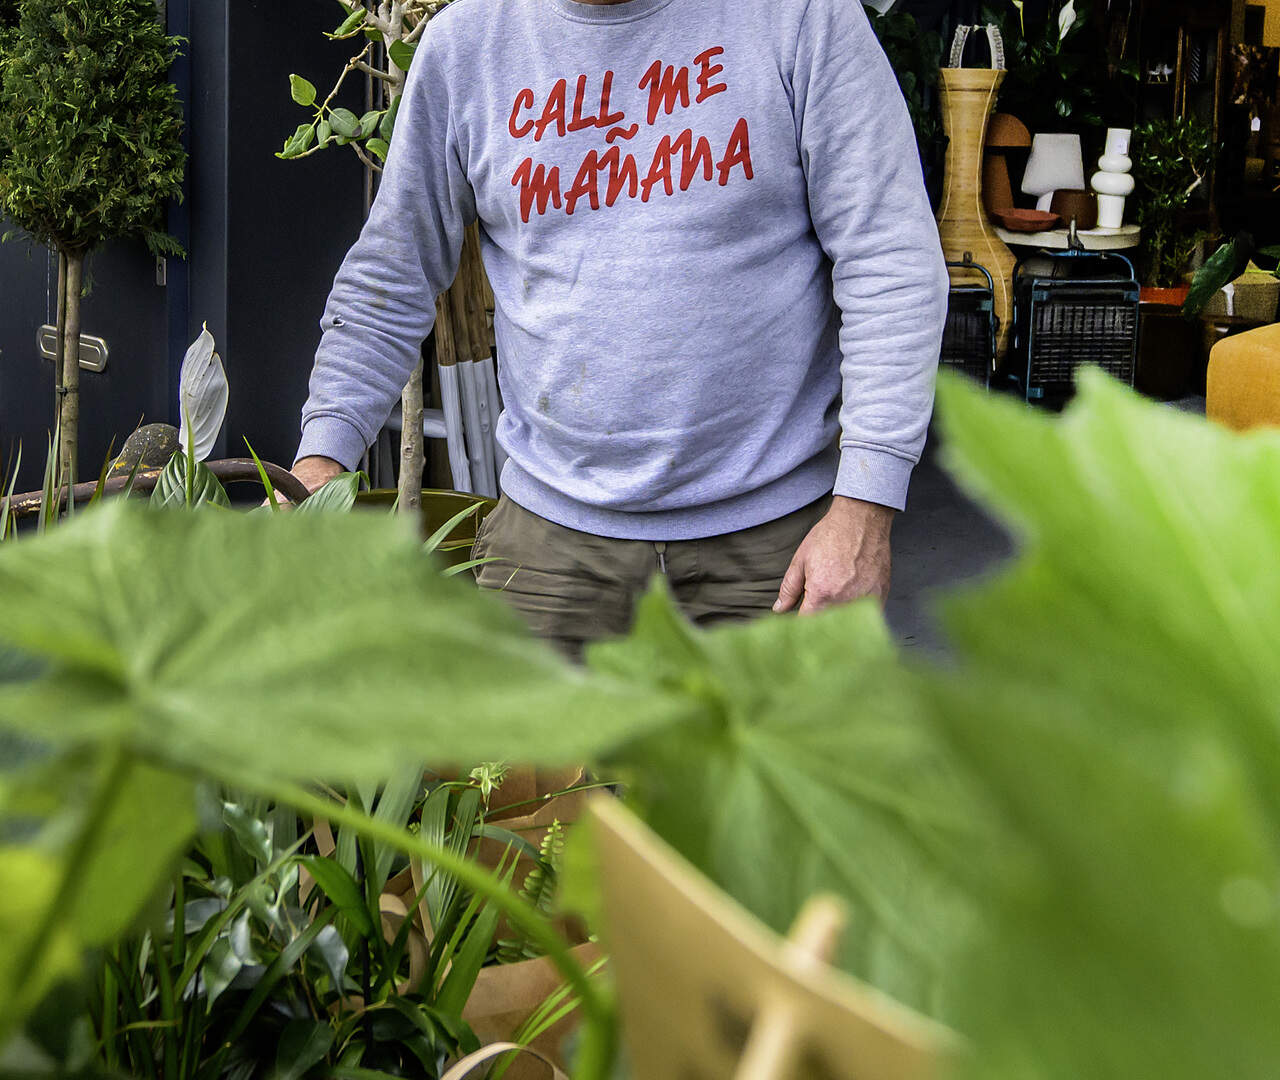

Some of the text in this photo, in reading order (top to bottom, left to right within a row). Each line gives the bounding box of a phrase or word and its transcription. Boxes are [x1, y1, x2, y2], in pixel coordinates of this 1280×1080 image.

[508, 46, 728, 142] CALL ME
[511, 118, 754, 223] MAÑANA
